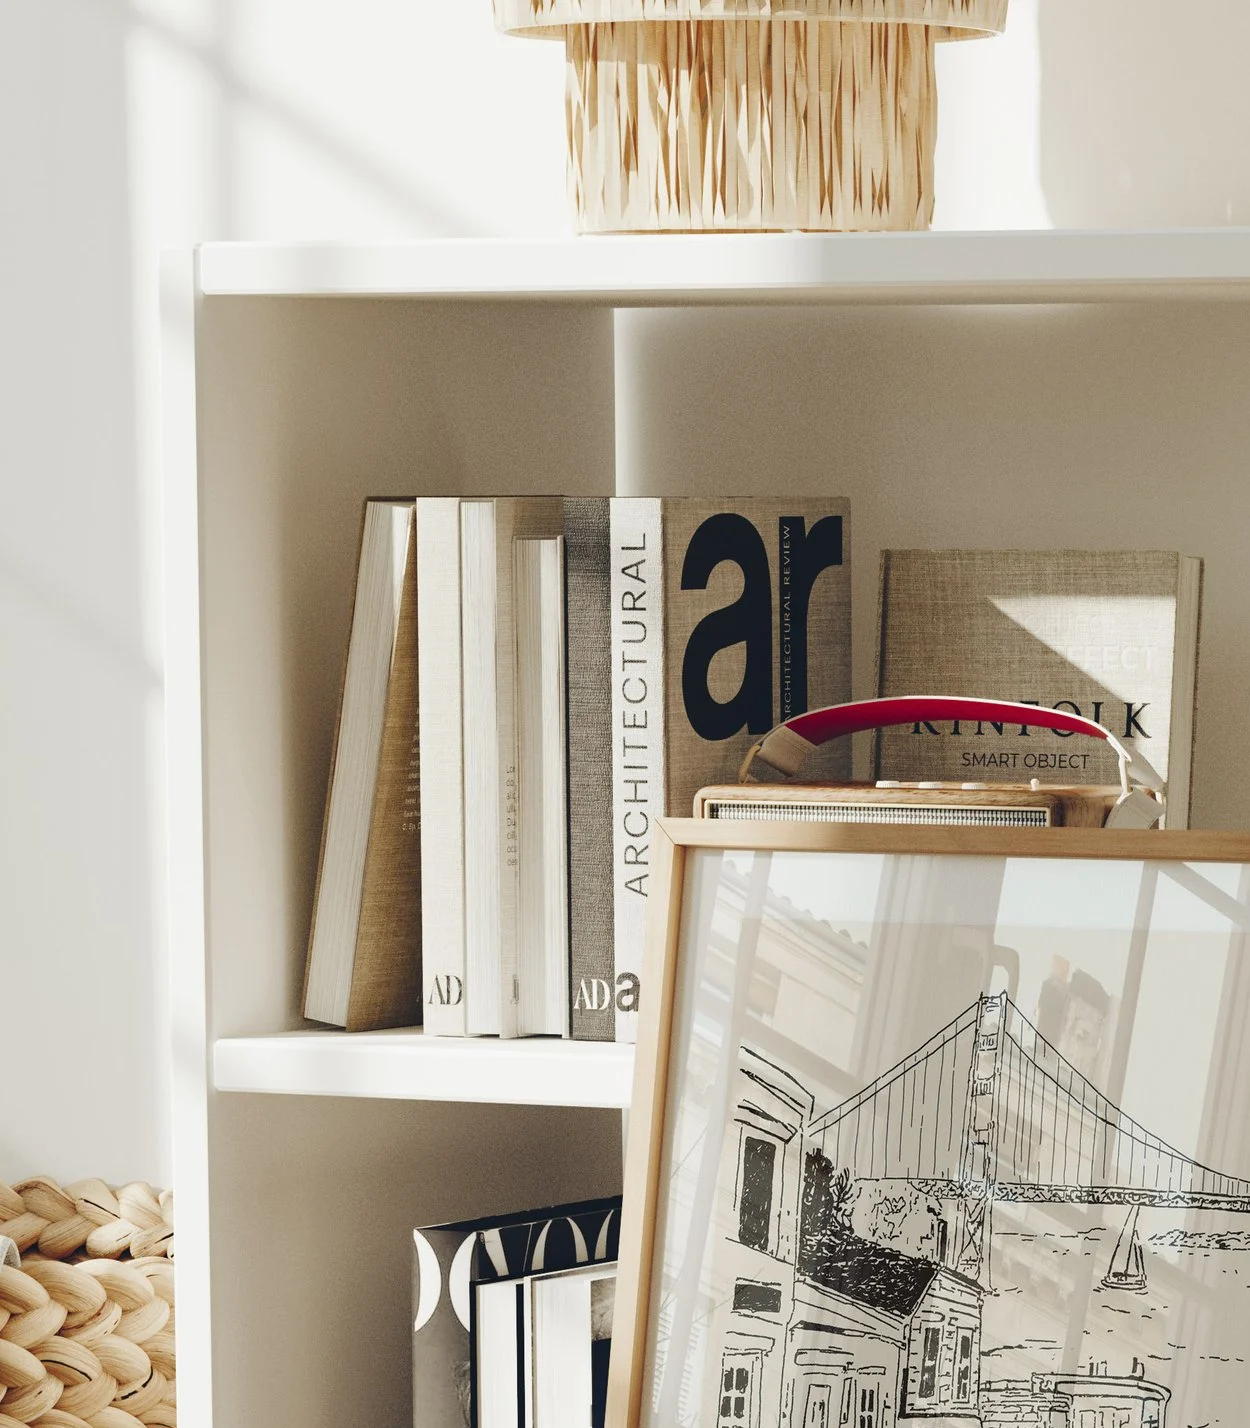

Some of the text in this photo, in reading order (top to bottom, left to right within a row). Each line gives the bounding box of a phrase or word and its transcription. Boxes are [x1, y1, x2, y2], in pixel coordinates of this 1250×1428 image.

[783, 525, 791, 585] REVIEW
[681, 513, 843, 741] ar
[621, 533, 650, 897] ARCHITECTURAL
[962, 752, 1090, 770] SMART OBJECT
[428, 974, 464, 1006] AD
[573, 978, 611, 1010] AD
